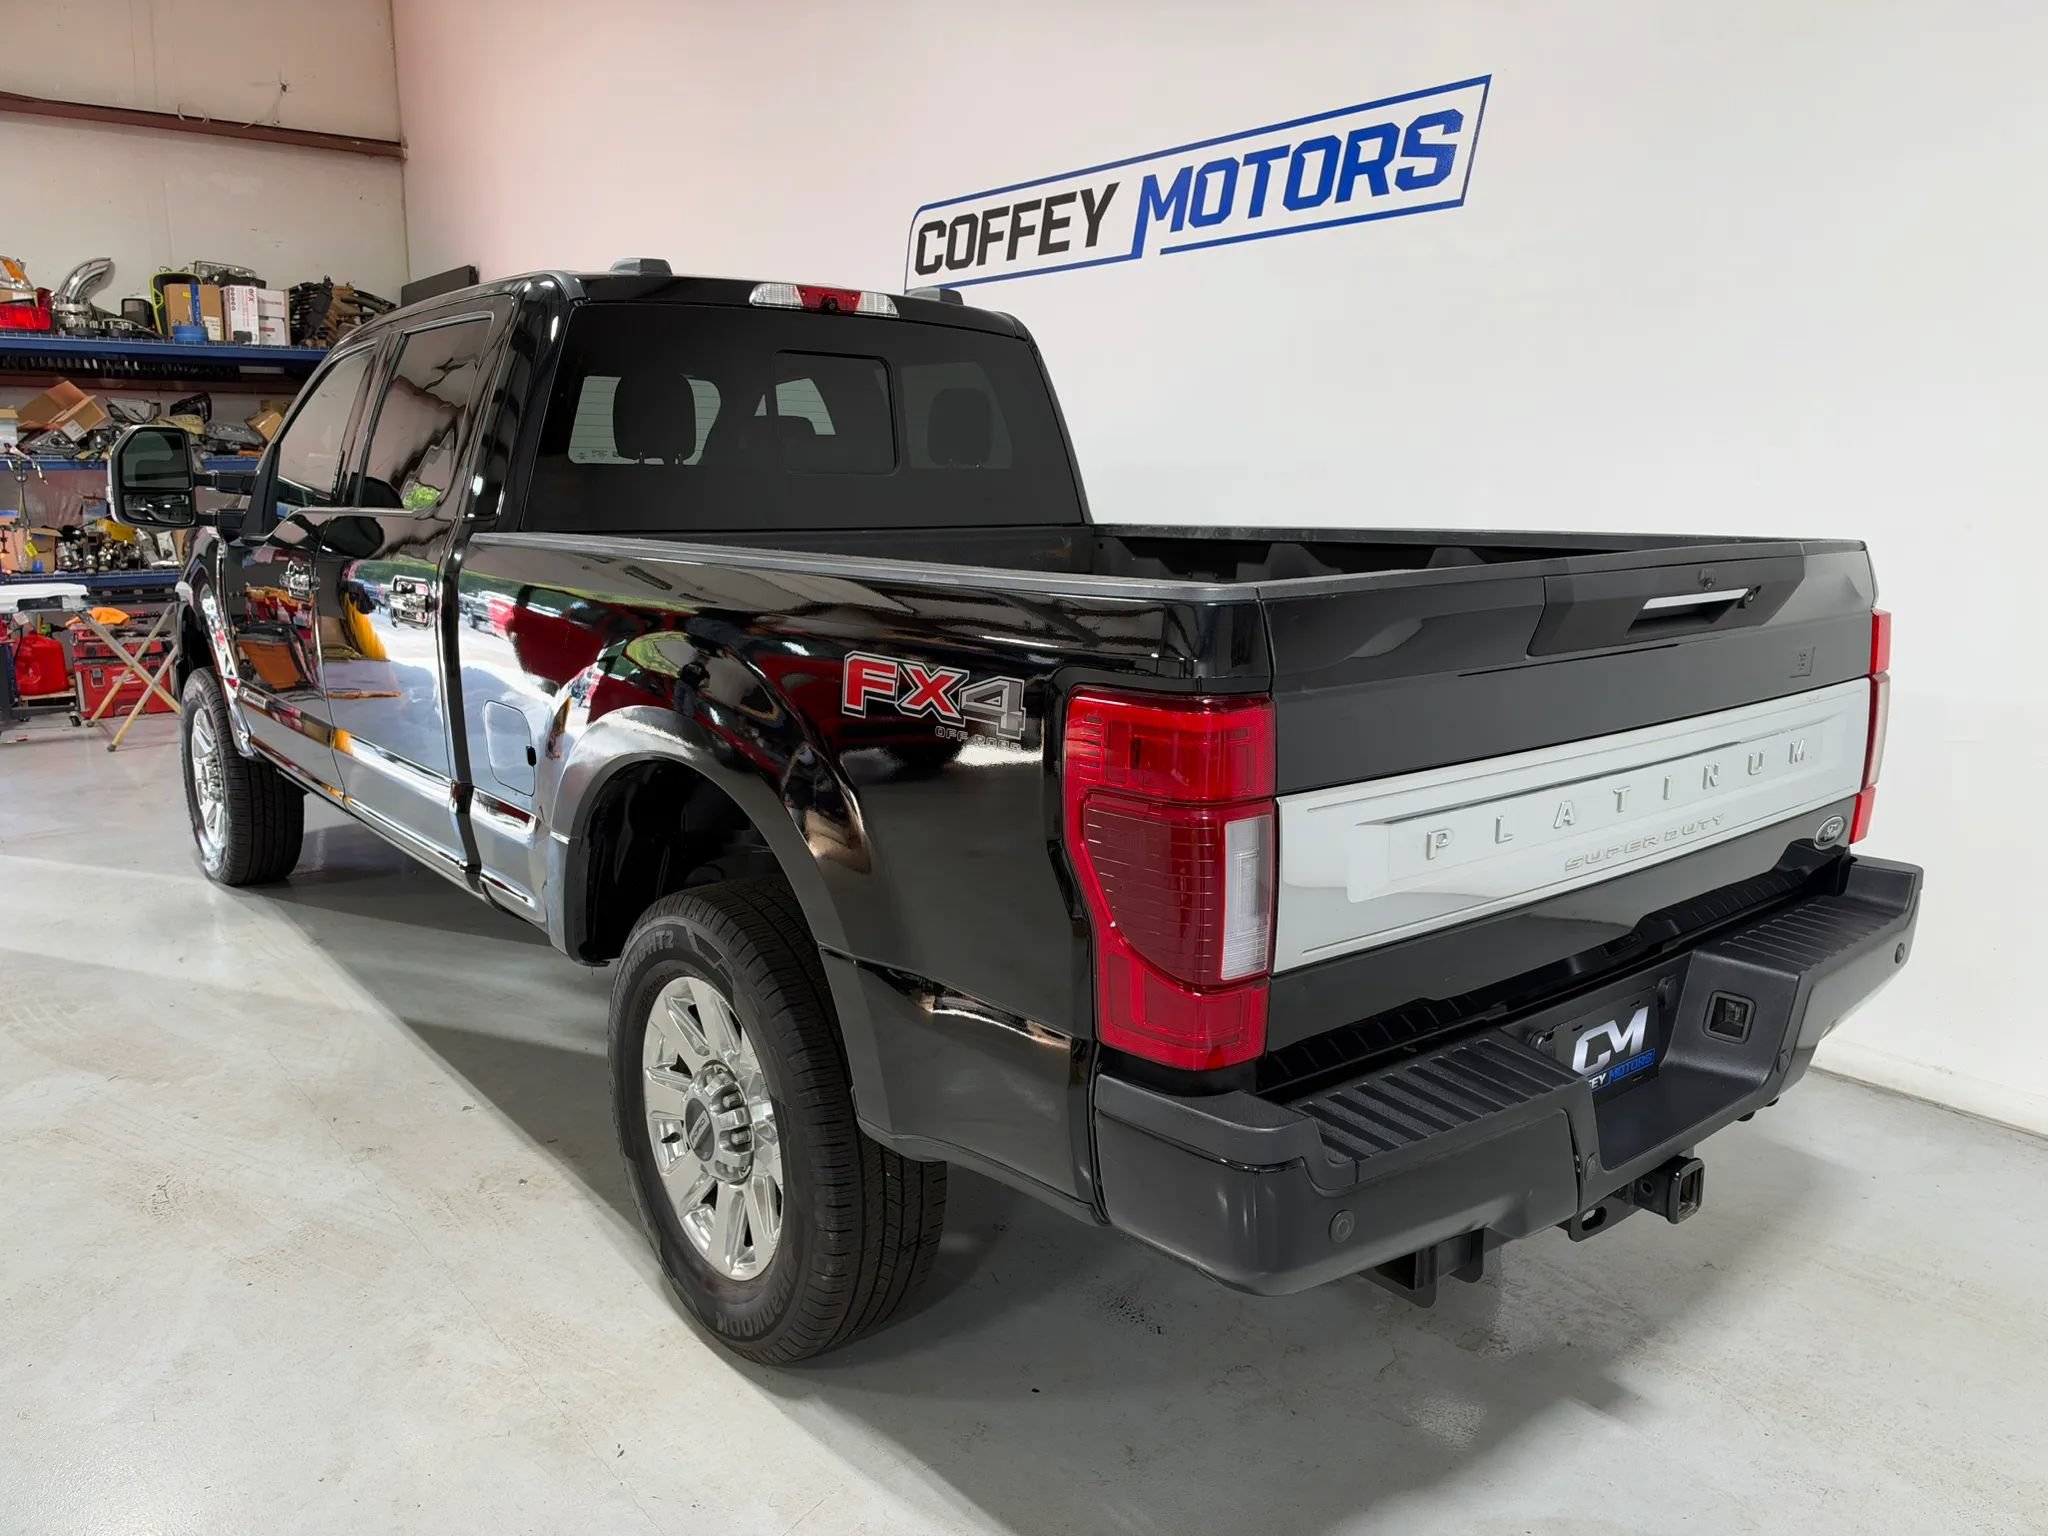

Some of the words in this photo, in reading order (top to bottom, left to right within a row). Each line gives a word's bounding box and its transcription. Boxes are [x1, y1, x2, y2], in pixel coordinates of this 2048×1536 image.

[914, 181, 1120, 276] COFFEY
[1131, 108, 1464, 257] MOTORS
[842, 650, 1026, 740] FX4
[935, 725, 968, 742] OFF
[1426, 738, 1806, 860] PLATINUM
[1564, 836, 1660, 872] SUPER
[1664, 813, 1725, 842] DUTY
[1572, 1006, 1649, 1076] CM
[1610, 1052, 1653, 1079] MOTORS
